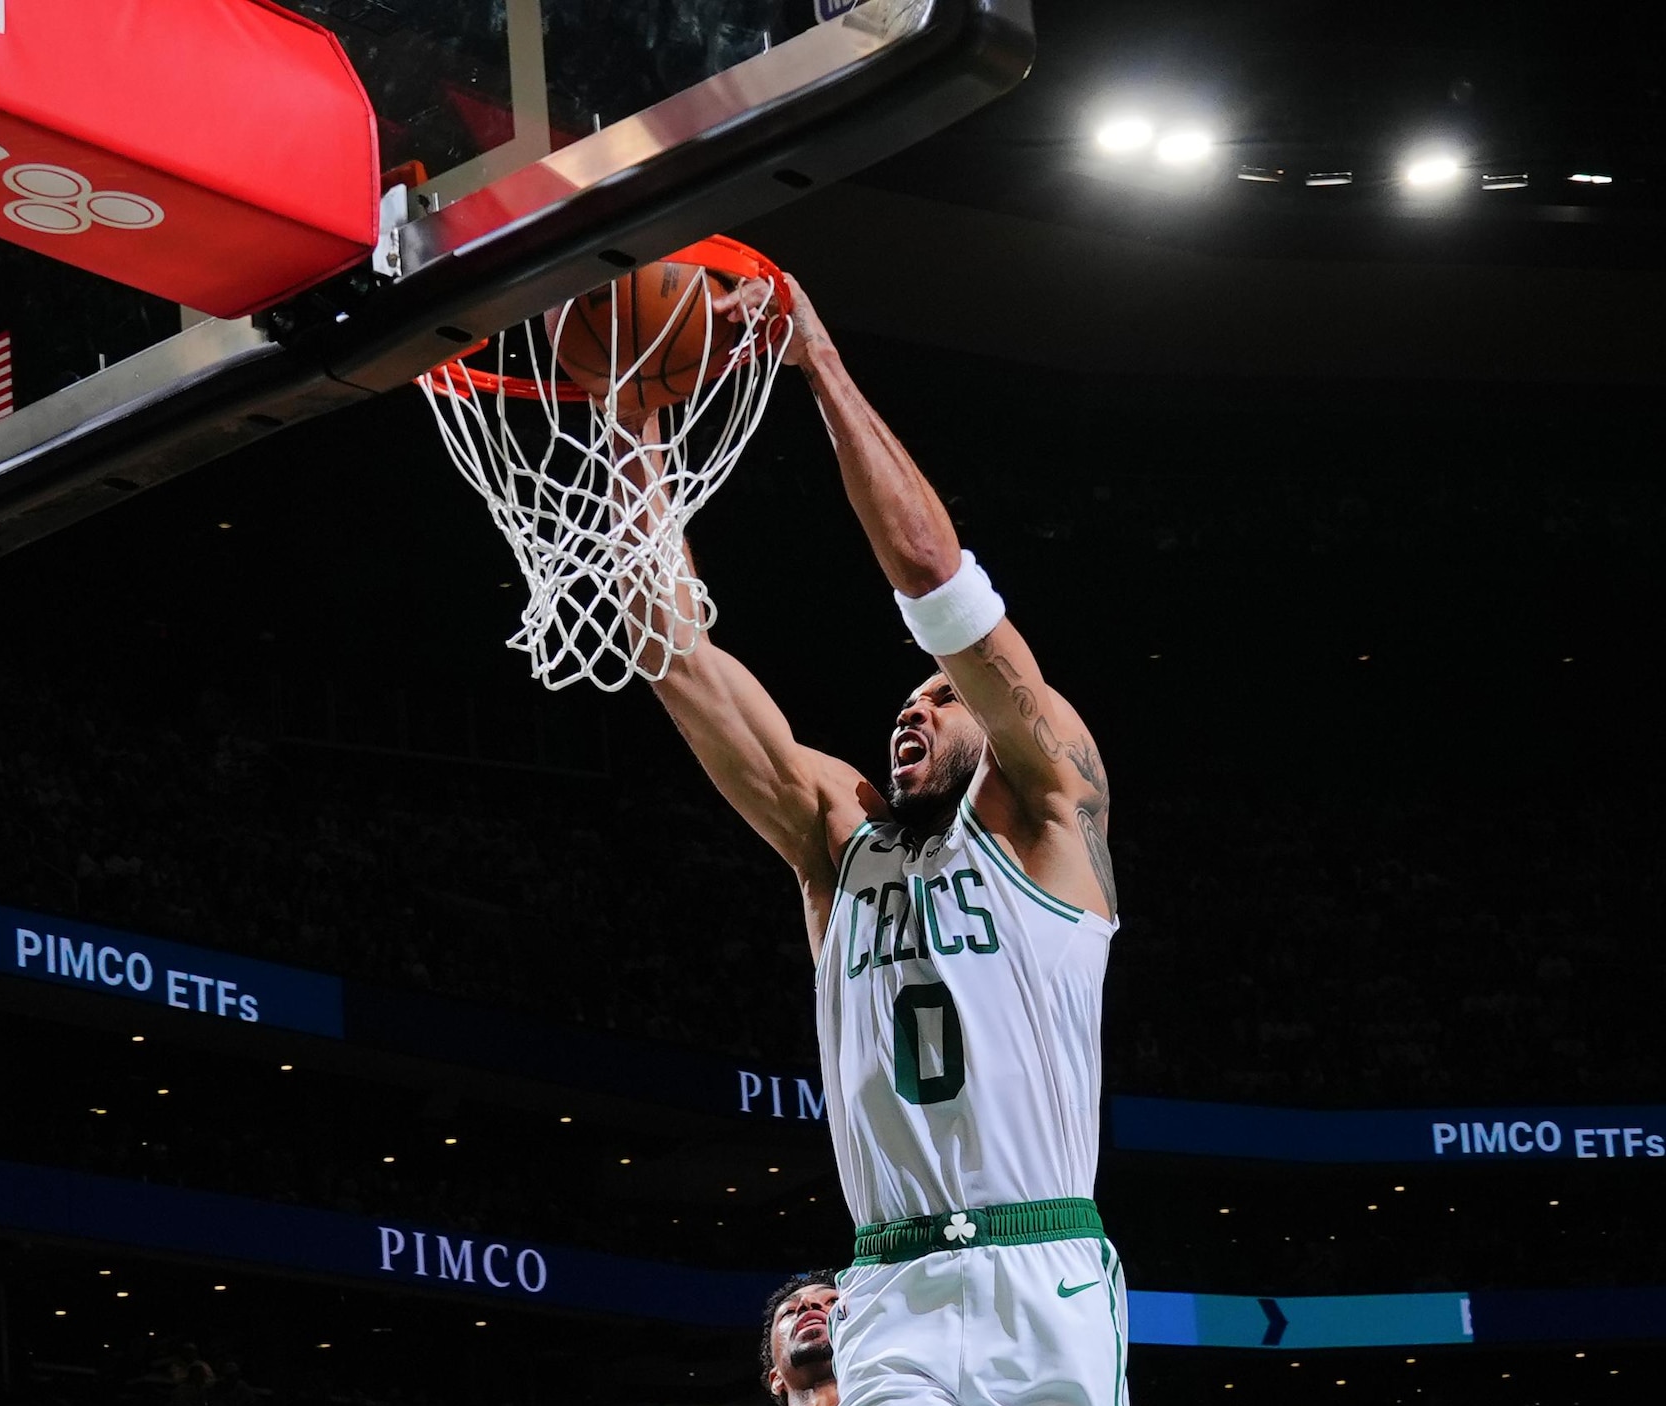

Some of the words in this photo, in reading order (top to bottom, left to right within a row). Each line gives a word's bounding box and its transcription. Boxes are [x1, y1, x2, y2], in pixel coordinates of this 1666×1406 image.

[16, 927, 153, 992] PIMCO
[166, 969, 259, 1023] ETFs
[893, 981, 965, 1104] 0
[737, 1069, 828, 1121] PIM
[1432, 1120, 1562, 1154] PIMCO
[1574, 1128, 1666, 1159] ETFs
[377, 1225, 547, 1293] PIMCO
